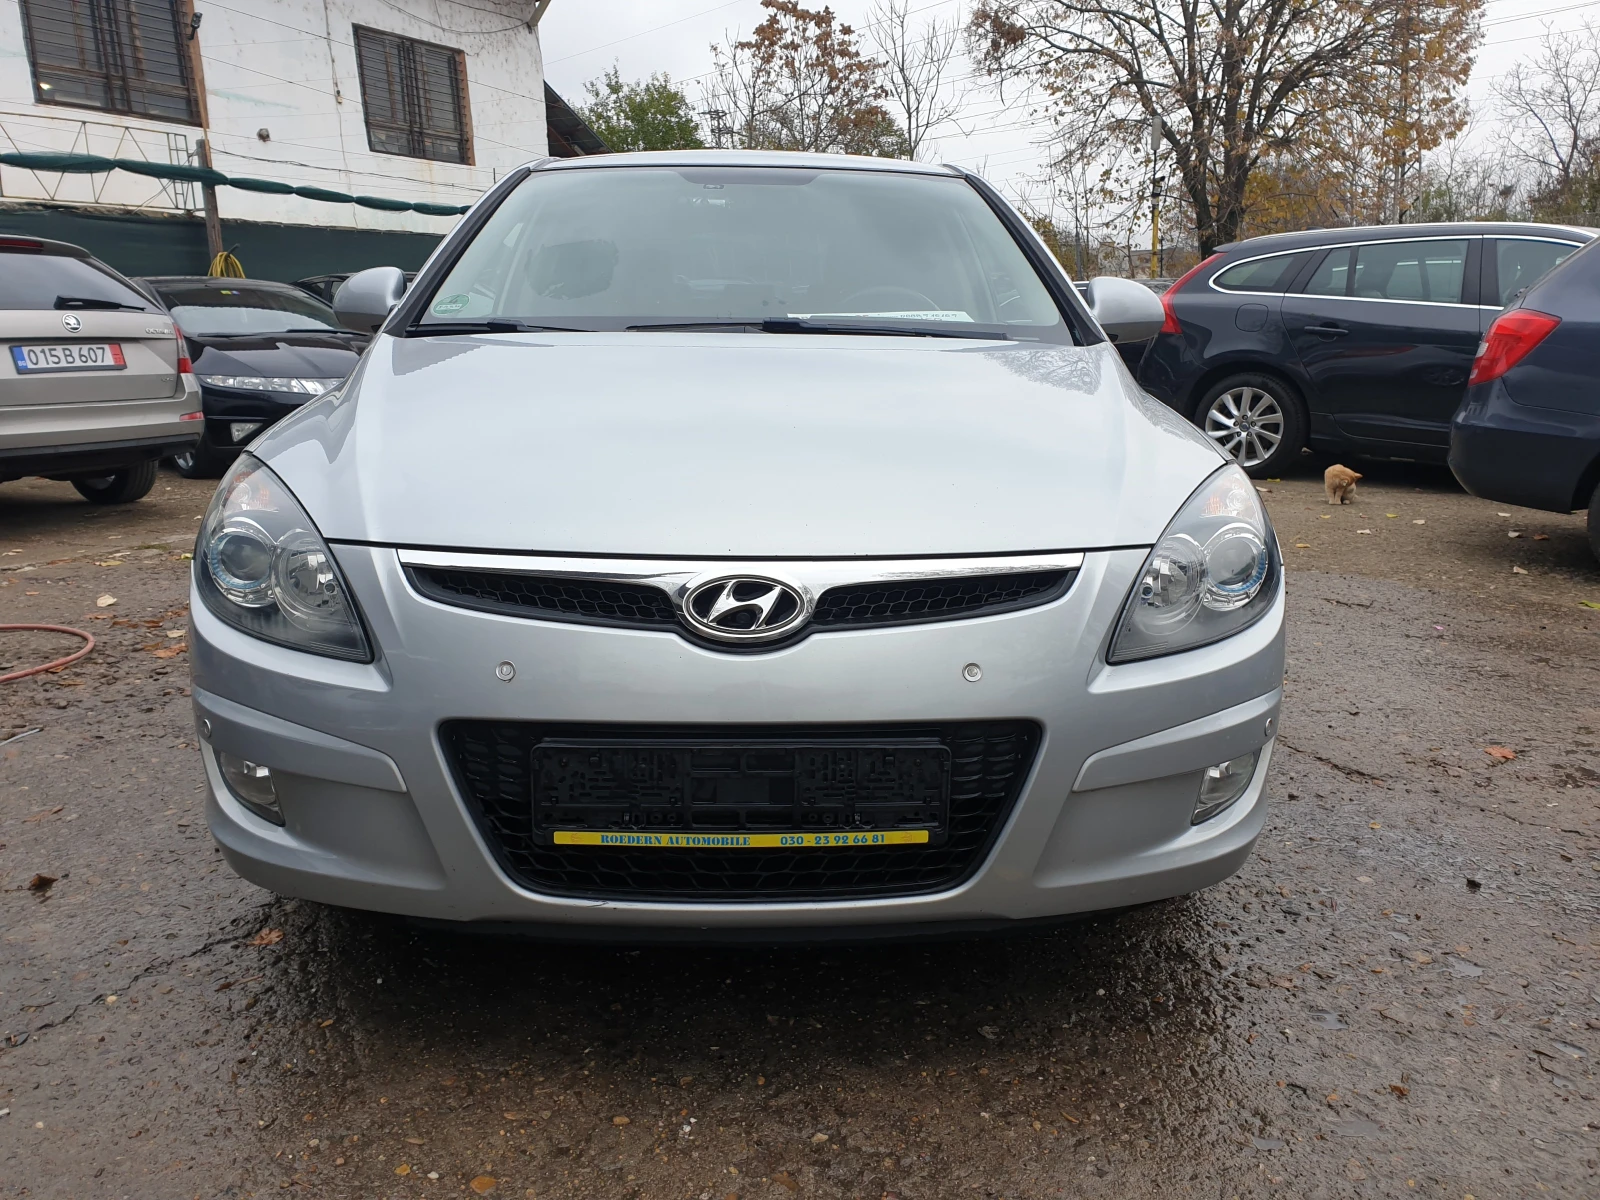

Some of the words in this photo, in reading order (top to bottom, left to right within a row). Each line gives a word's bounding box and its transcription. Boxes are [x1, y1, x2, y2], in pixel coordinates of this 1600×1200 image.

[601, 834, 662, 845] ROEDERN
[666, 835, 751, 846] AUTOMOBILE
[780, 836, 804, 846] 030
[814, 835, 830, 845] 23
[833, 835, 849, 845] 92
[852, 834, 868, 844] 66
[871, 834, 885, 843] 81
